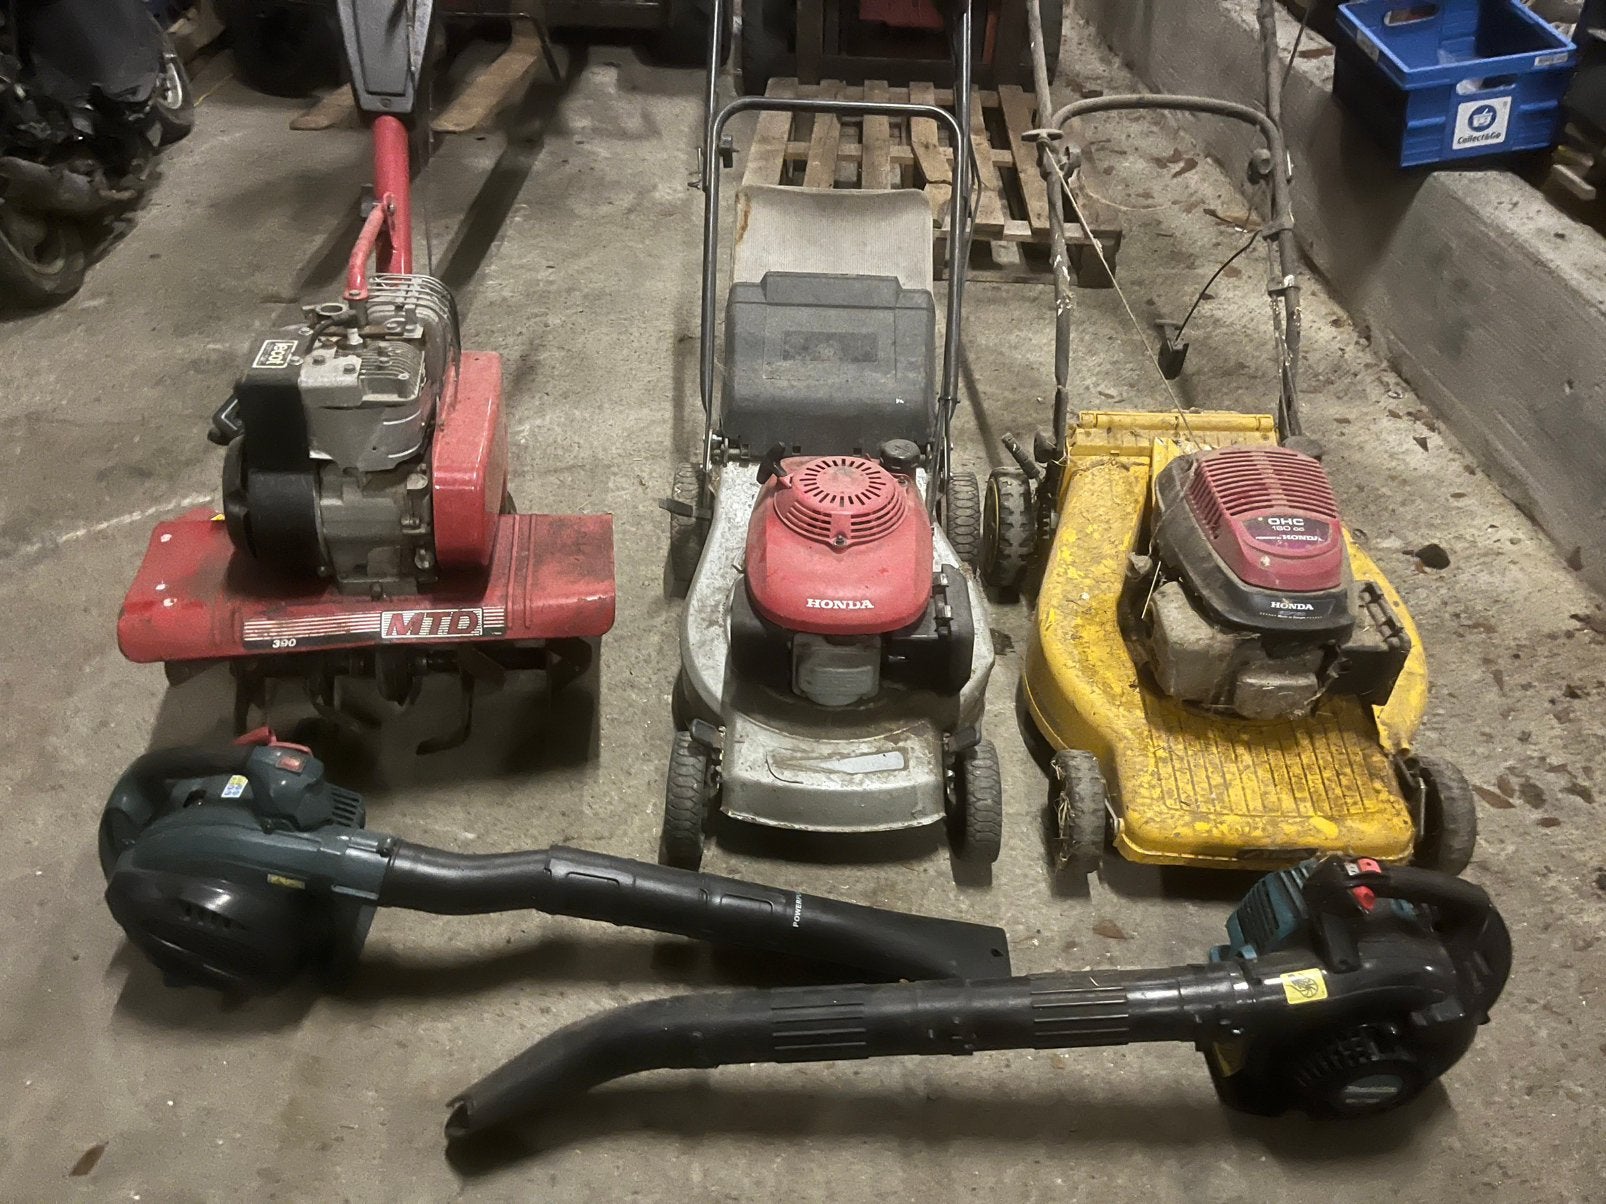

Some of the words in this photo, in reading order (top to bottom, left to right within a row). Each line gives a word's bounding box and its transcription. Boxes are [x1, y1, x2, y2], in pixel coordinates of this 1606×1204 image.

[1268, 517, 1304, 526] OHC
[806, 598, 875, 610] HONDA
[1270, 601, 1314, 610] HONDA
[386, 611, 479, 636] MTD
[272, 638, 296, 648] 390
